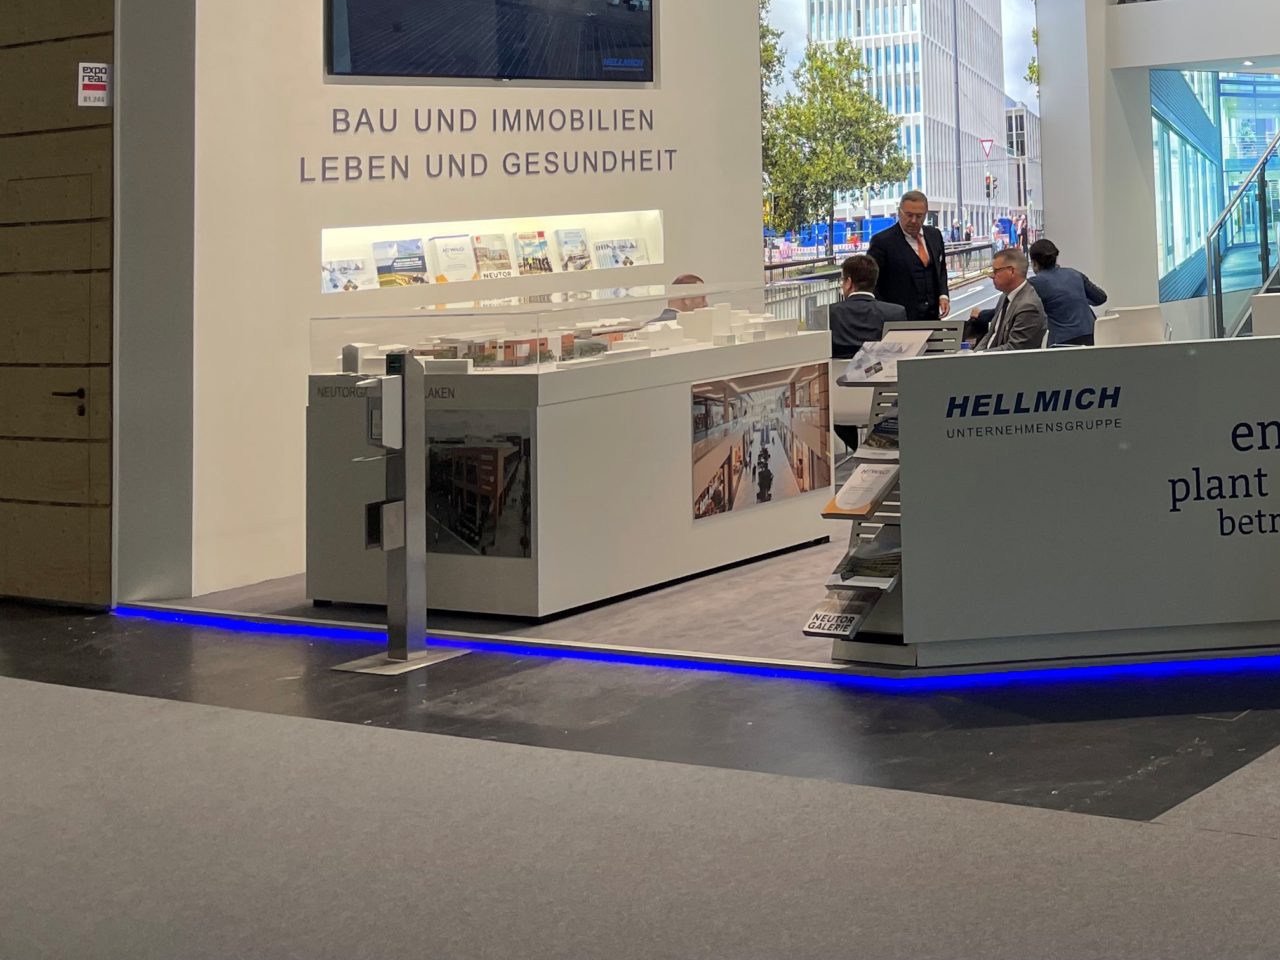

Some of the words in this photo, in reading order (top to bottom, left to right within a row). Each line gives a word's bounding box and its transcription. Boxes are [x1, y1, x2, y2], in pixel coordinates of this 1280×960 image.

[82, 66, 107, 76] expo
[332, 107, 398, 134] BAU
[413, 107, 478, 133] UND
[491, 107, 655, 133] IMMOBILIEN
[300, 154, 410, 184] LEBEN
[425, 152, 488, 179] UND
[502, 148, 679, 177] GESUNDHEIT
[483, 270, 512, 279] NEUTOR
[945, 385, 1122, 418] HELLMICH
[946, 418, 1123, 439] UNTERNEHMENSGRUPPE
[1167, 466, 1269, 513] plant
[807, 621, 851, 633] GALERIE
[812, 613, 856, 624] NEUTOR
